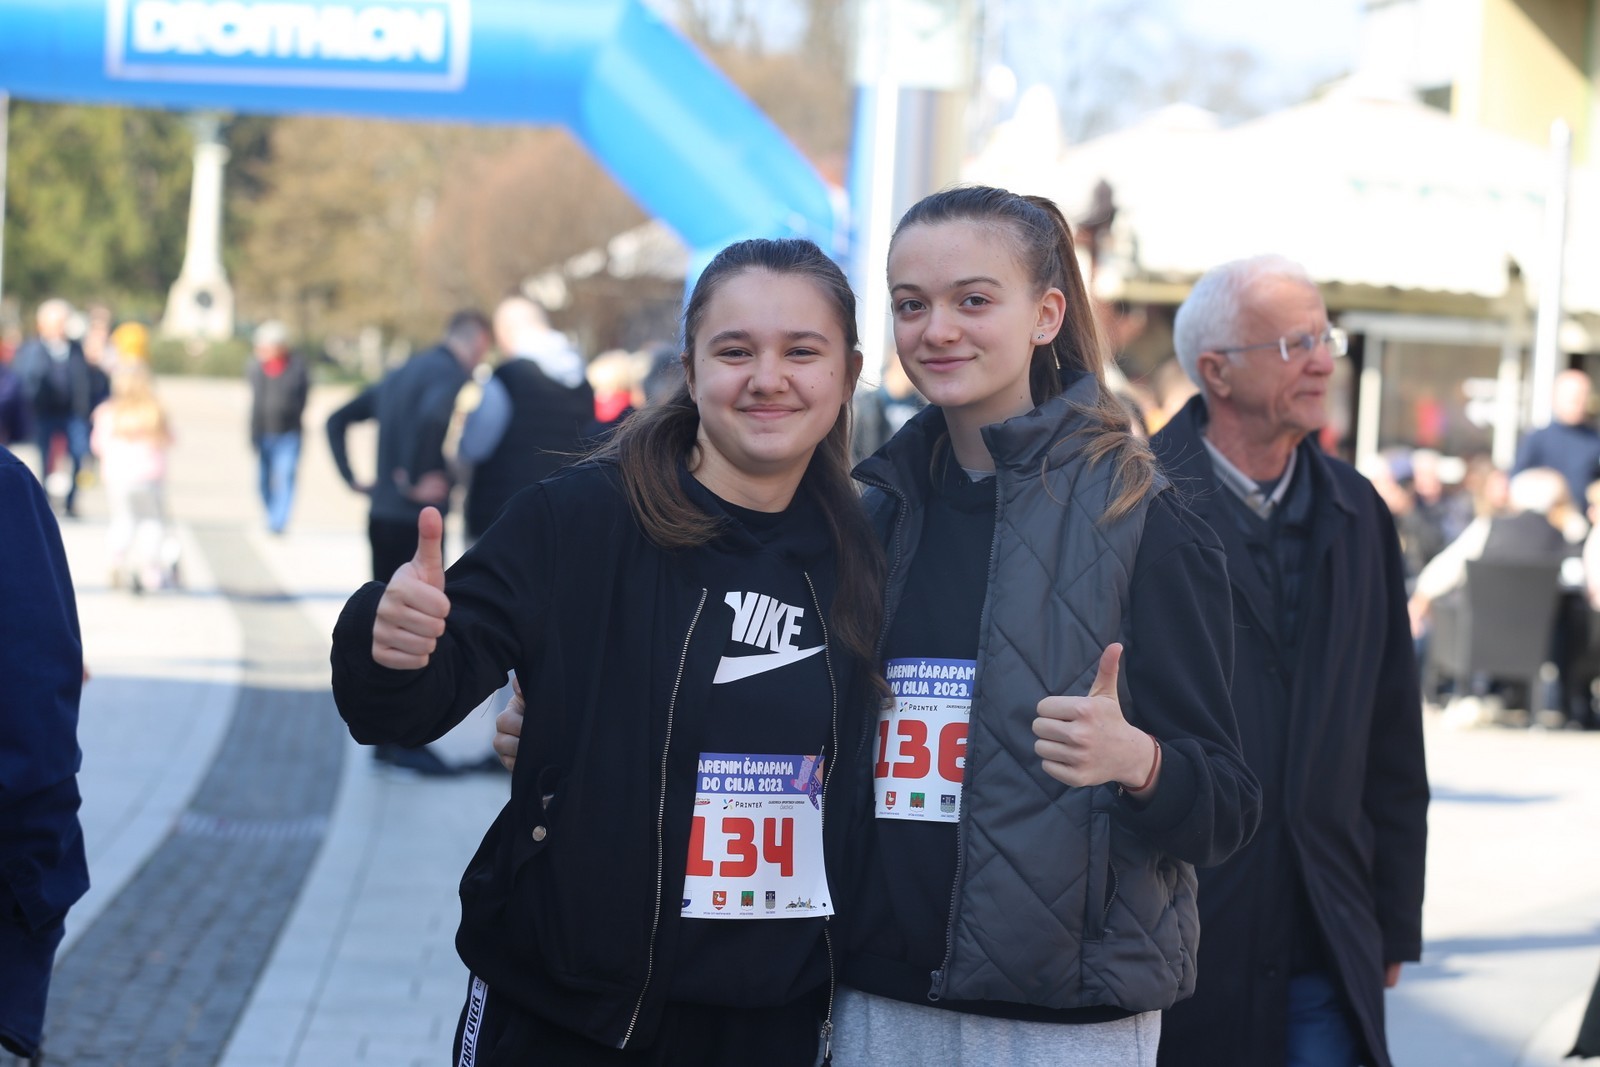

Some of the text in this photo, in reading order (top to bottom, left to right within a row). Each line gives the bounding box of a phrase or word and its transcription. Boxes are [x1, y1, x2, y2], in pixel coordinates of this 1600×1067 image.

[133, 0, 445, 63] DECATHLON
[724, 591, 805, 653] NIKE
[902, 681, 929, 695] CILJA
[933, 682, 970, 697] 2023.
[918, 661, 976, 680] ČARAPAM
[697, 757, 794, 775] ARENIM ČARAPAMA
[875, 719, 969, 784] 136
[702, 777, 784, 792] DO CILJA 2023.
[685, 816, 794, 877] 134
[460, 1032, 473, 1067] TART
[467, 995, 481, 1035] OVER
